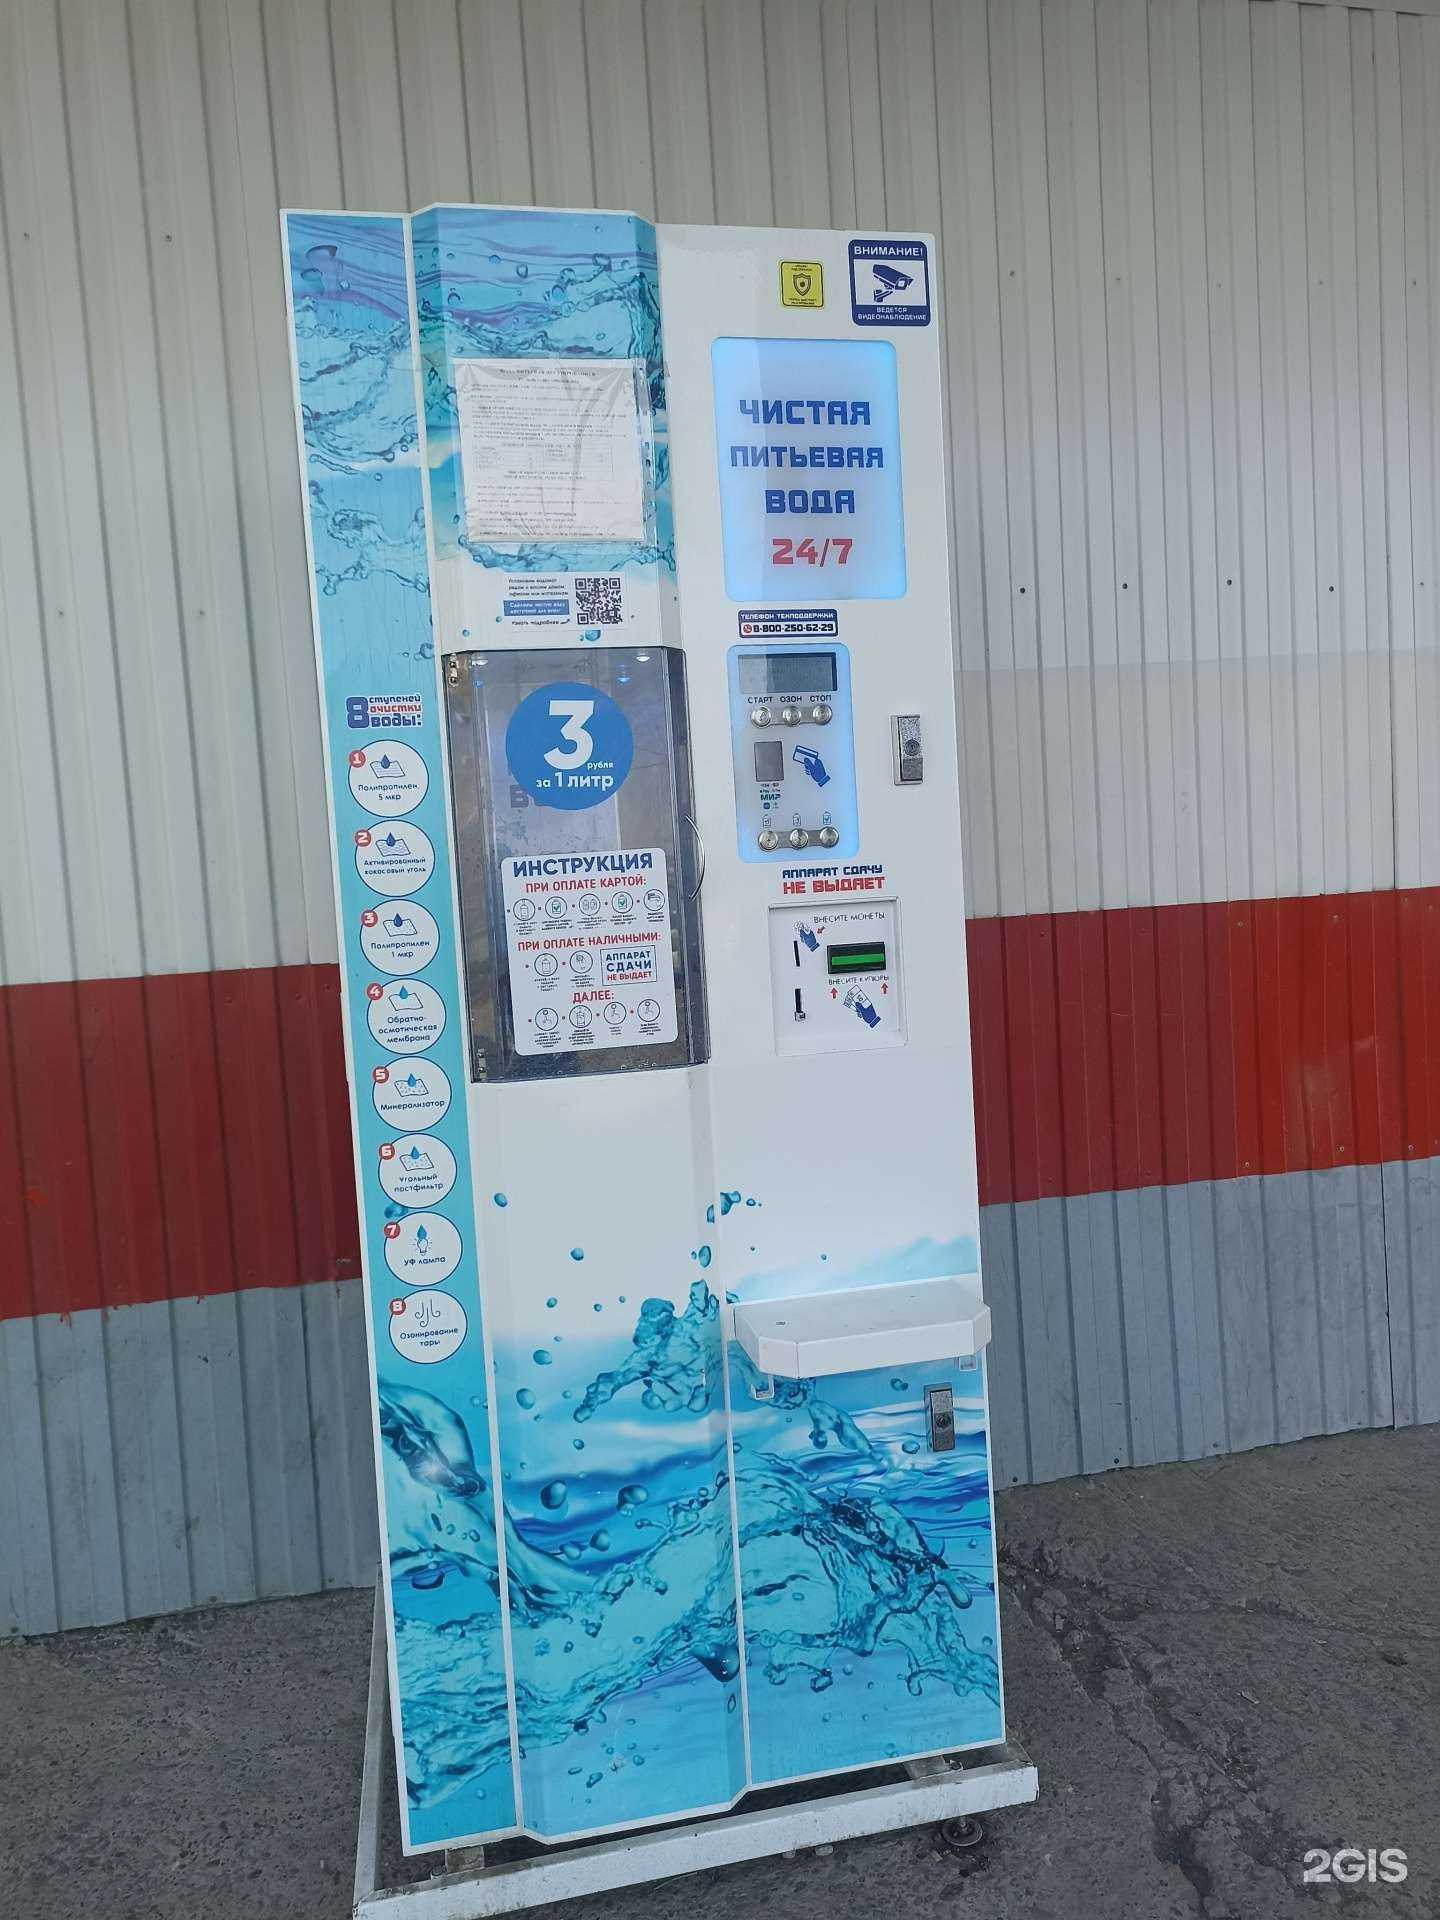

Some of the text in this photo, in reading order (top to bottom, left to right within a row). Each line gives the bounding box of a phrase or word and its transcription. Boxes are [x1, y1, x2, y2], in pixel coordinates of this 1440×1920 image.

[854, 246, 923, 256] ВНИМАНИЕ!
[857, 313, 927, 321] ВИДЕОНАБЛЮДЕНИЕ
[740, 400, 871, 426] ЧИСТАЯ
[730, 446, 884, 468] ПИТЬЕВАЯ
[765, 490, 856, 514] ВОДА
[772, 538, 853, 567] 24/7
[753, 624, 834, 633] 8-800-250-62-29
[748, 694, 832, 704] СТАРТ ОЗОН СТОП
[346, 694, 421, 728] 8 ступеней
[370, 704, 422, 713] очистки
[370, 713, 422, 728] воды:
[544, 700, 594, 770] 3
[353, 752, 362, 765] 1
[587, 762, 614, 770] рубля
[536, 771, 614, 791] за 1 литр
[358, 783, 418, 792] Полипропилен
[386, 794, 402, 802] мкр
[358, 832, 369, 844] 2
[364, 858, 426, 866] Активированный
[513, 852, 653, 878] ИНСТРУКЦИЯ
[407, 866, 427, 874] уголь
[782, 864, 884, 878] АППАРАТ СДАЧУ
[526, 874, 647, 894] ПРИ ОПЛАТЕ КАРТОЙ:
[784, 876, 886, 894] НЕ ВЫДАЕТ
[365, 912, 375, 924] 3
[814, 912, 886, 924] ВНЕСИТЕ МОНЕТЫ
[370, 940, 430, 950] Полипропилен
[518, 932, 662, 952] ПРИ ОПЛАТЕ НАЛИЧНЫМИ:
[398, 950, 414, 958] мкр
[606, 950, 651, 961] АППАРАТ
[606, 960, 652, 972] СДАЧИ
[608, 971, 652, 982] НЕ ВЫДАЕТ
[828, 976, 858, 985] ВНЕСИТЕ
[369, 986, 381, 997] 4
[572, 990, 615, 1004] ДАЛЕЕ:
[387, 1015, 427, 1024] Обратно-
[378, 1024, 438, 1034] осмотическая
[387, 1034, 431, 1044] мембрана
[376, 1069, 386, 1080] 5
[380, 1100, 446, 1111] Минерализатор
[382, 1145, 392, 1156] 6
[394, 1182, 444, 1193] постфильтр
[386, 1224, 398, 1236] 7
[418, 1256, 446, 1266] лампа
[392, 1301, 403, 1313] 8
[400, 1328, 458, 1340] Озонирование
[420, 1339, 441, 1348] тары
